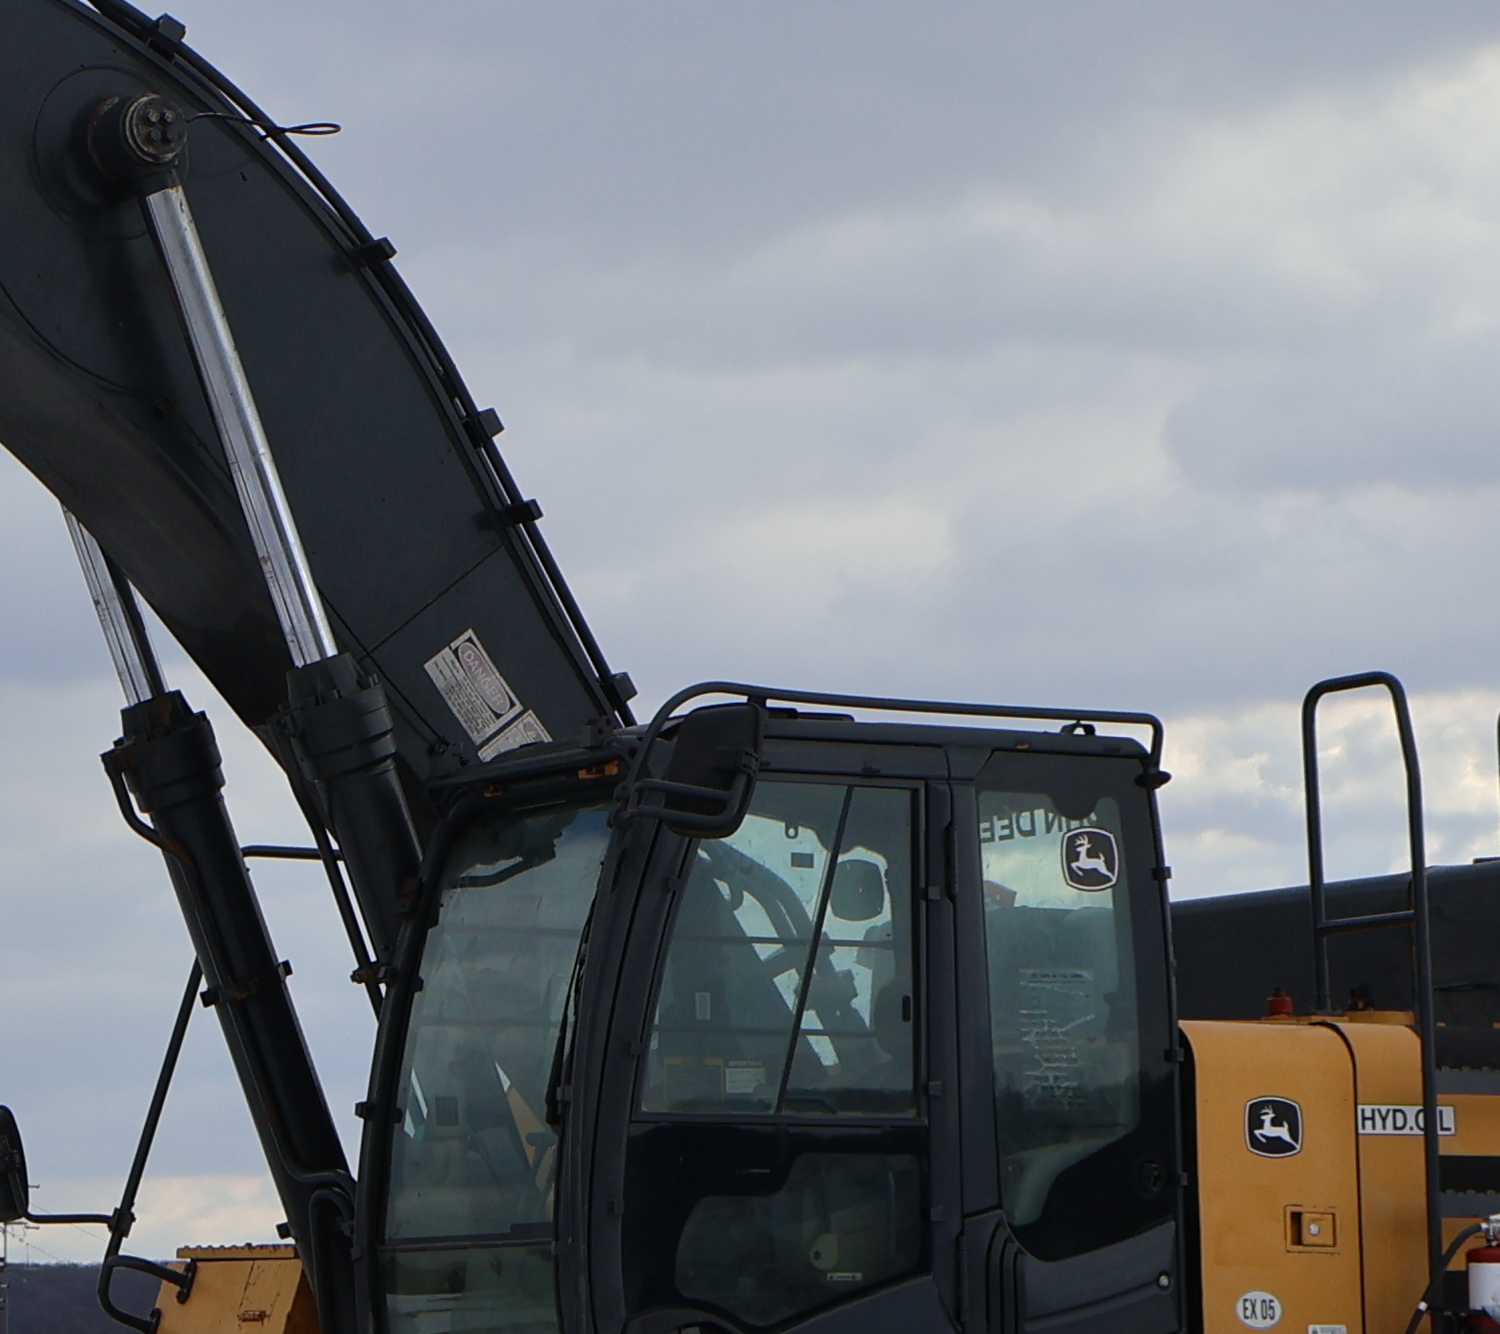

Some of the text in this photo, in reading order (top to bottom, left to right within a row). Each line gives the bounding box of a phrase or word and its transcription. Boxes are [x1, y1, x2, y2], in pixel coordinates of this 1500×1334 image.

[463, 649, 505, 708] DANGER
[1361, 1108, 1452, 1132] HYD.OL
[1243, 1298, 1275, 1320] EX 05
